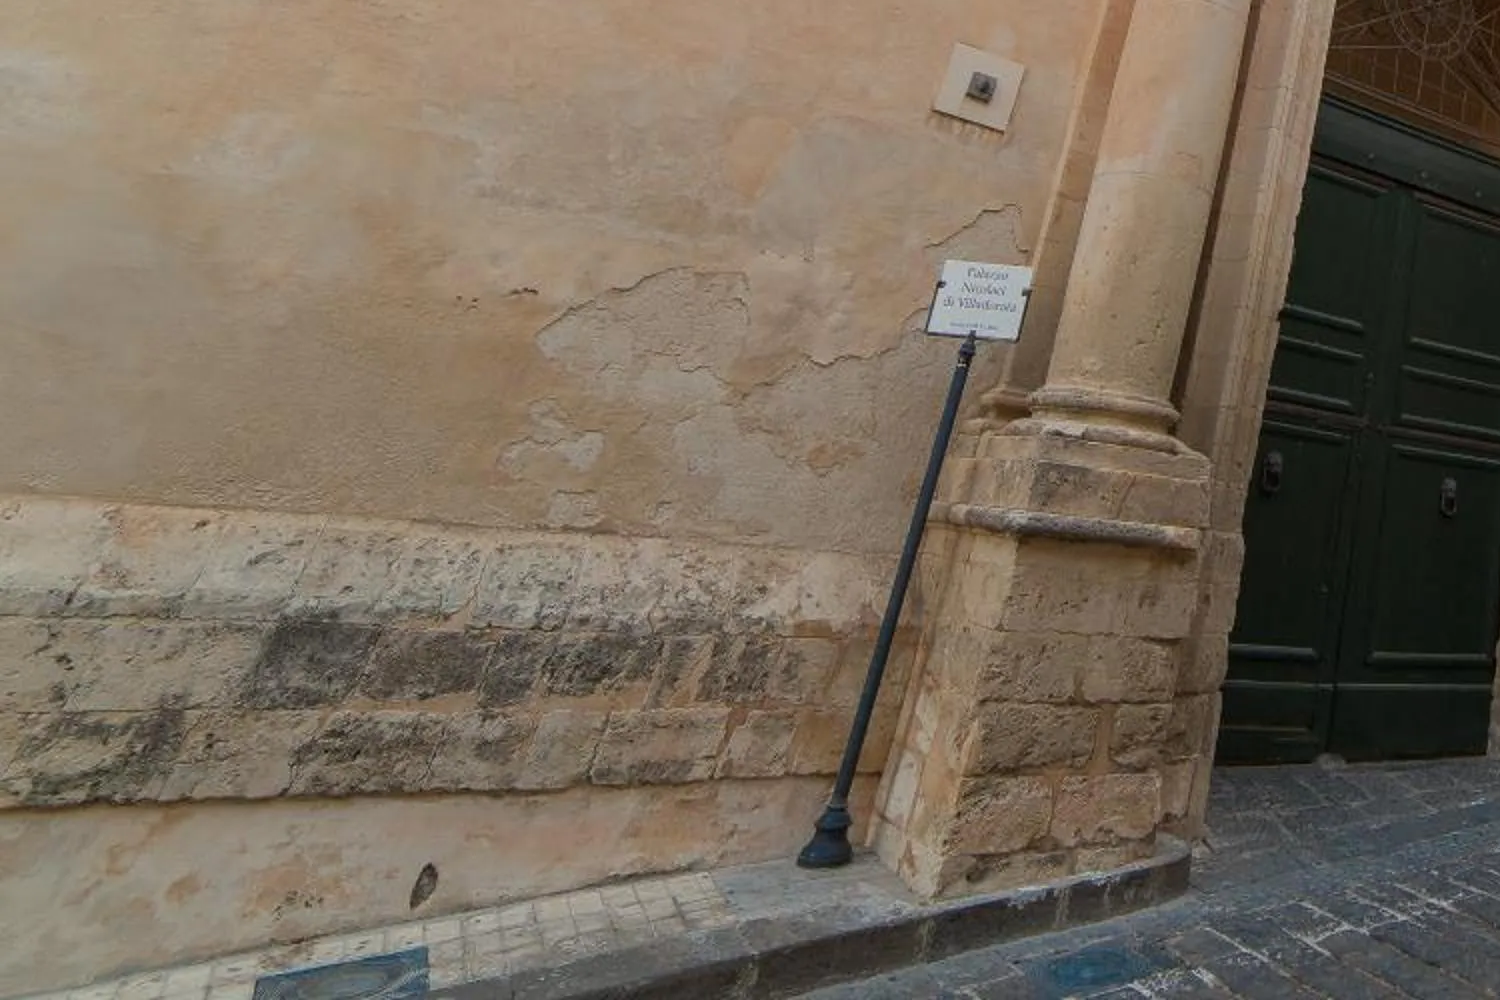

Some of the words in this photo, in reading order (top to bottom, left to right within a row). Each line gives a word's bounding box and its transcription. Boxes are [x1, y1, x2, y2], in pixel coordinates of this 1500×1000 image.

[967, 267, 1009, 280] Palazzo
[961, 282, 1008, 296] Nicolaci
[943, 296, 955, 307] di
